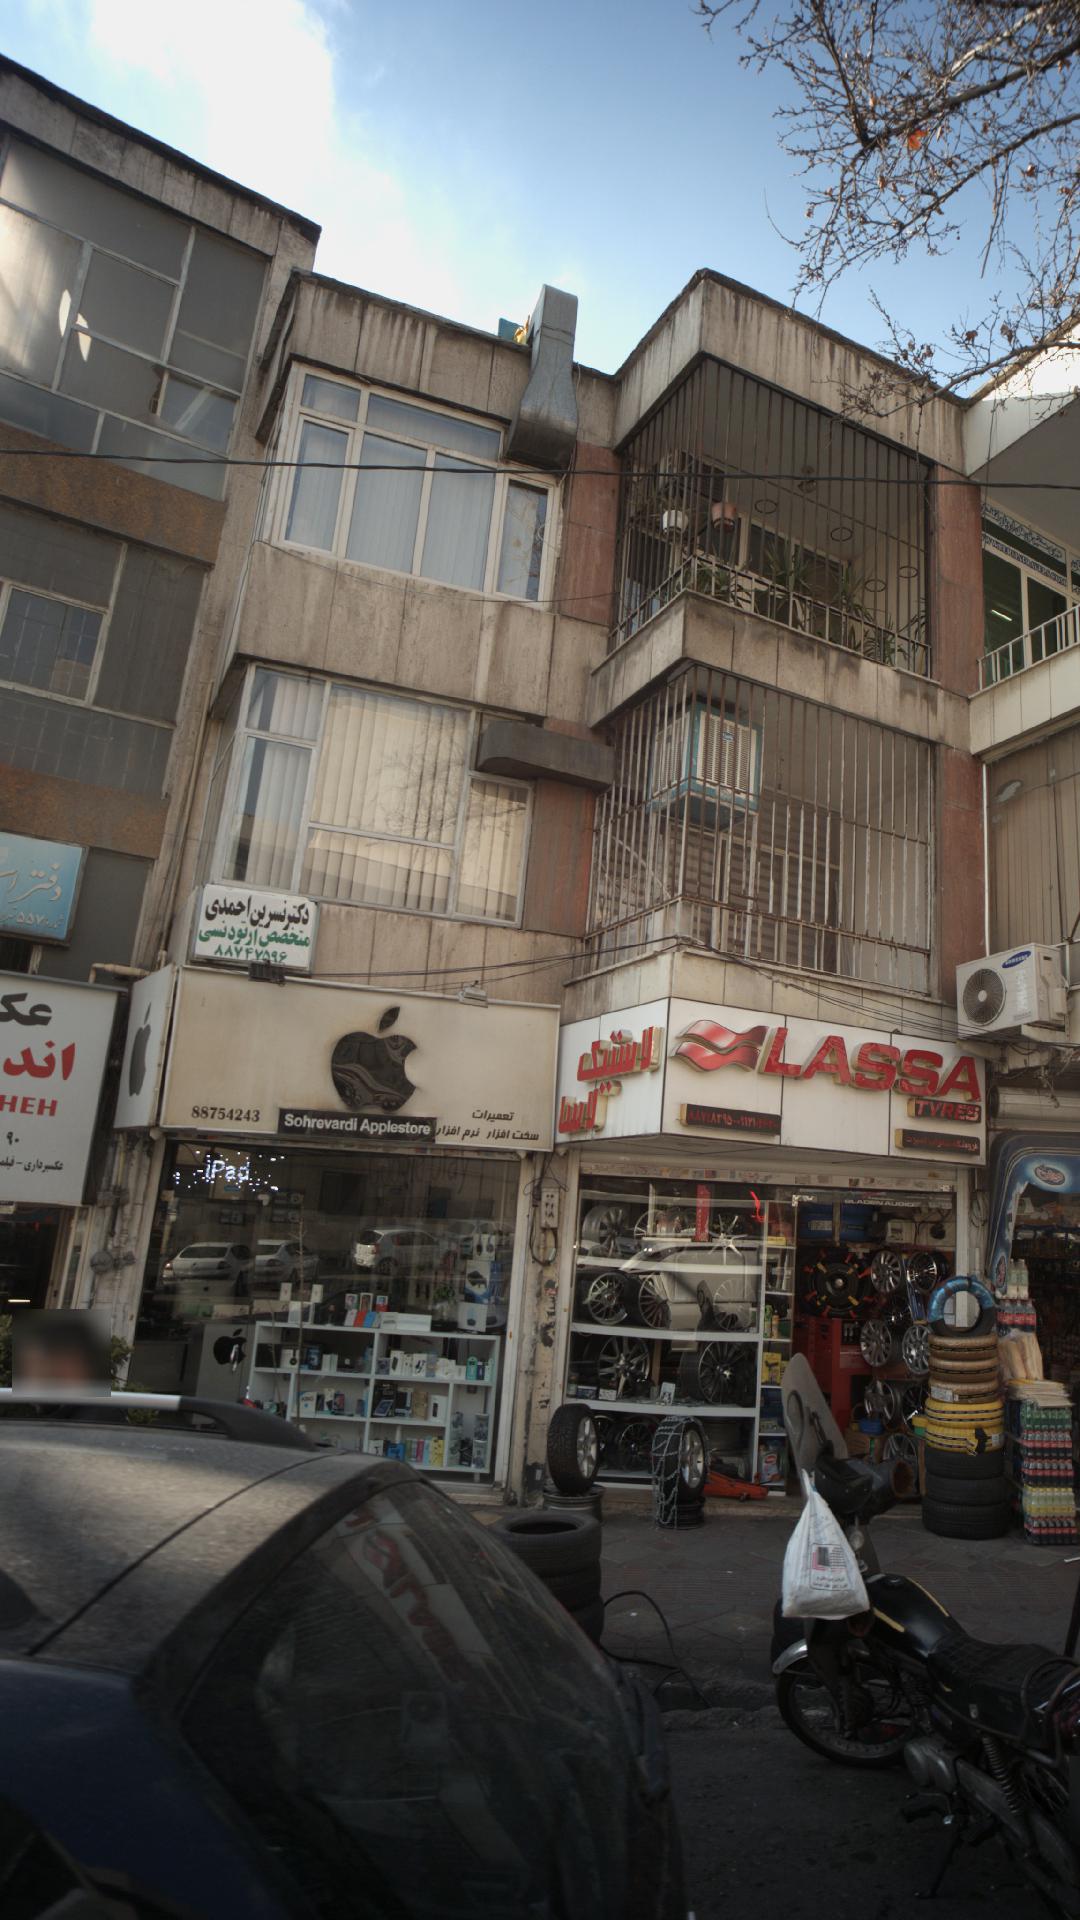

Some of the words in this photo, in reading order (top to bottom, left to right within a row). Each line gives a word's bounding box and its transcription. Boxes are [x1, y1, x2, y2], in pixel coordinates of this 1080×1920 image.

[204, 894, 252, 921] احمدی
[250, 899, 288, 929] نسرین
[282, 903, 310, 931] دکتر
[198, 920, 258, 946] ارتودنسی
[259, 926, 311, 948] متخصص
[213, 944, 288, 963] ۸۸۷۴۷۵۹۶
[576, 1026, 657, 1095] لاستیک
[762, 1026, 982, 1103] LASSA
[191, 1104, 261, 1123] 88754243
[284, 1113, 358, 1131] Sohrevardi
[359, 1117, 431, 1136] Applestore
[471, 1109, 516, 1123] تعمیرات
[435, 1124, 460, 1137] افزار
[461, 1126, 480, 1141] نرم
[486, 1127, 510, 1140] افزار
[512, 1129, 539, 1141] سخت
[23, 1157, 64, 1173] عکسبرداری
[204, 1159, 250, 1181] iPad
